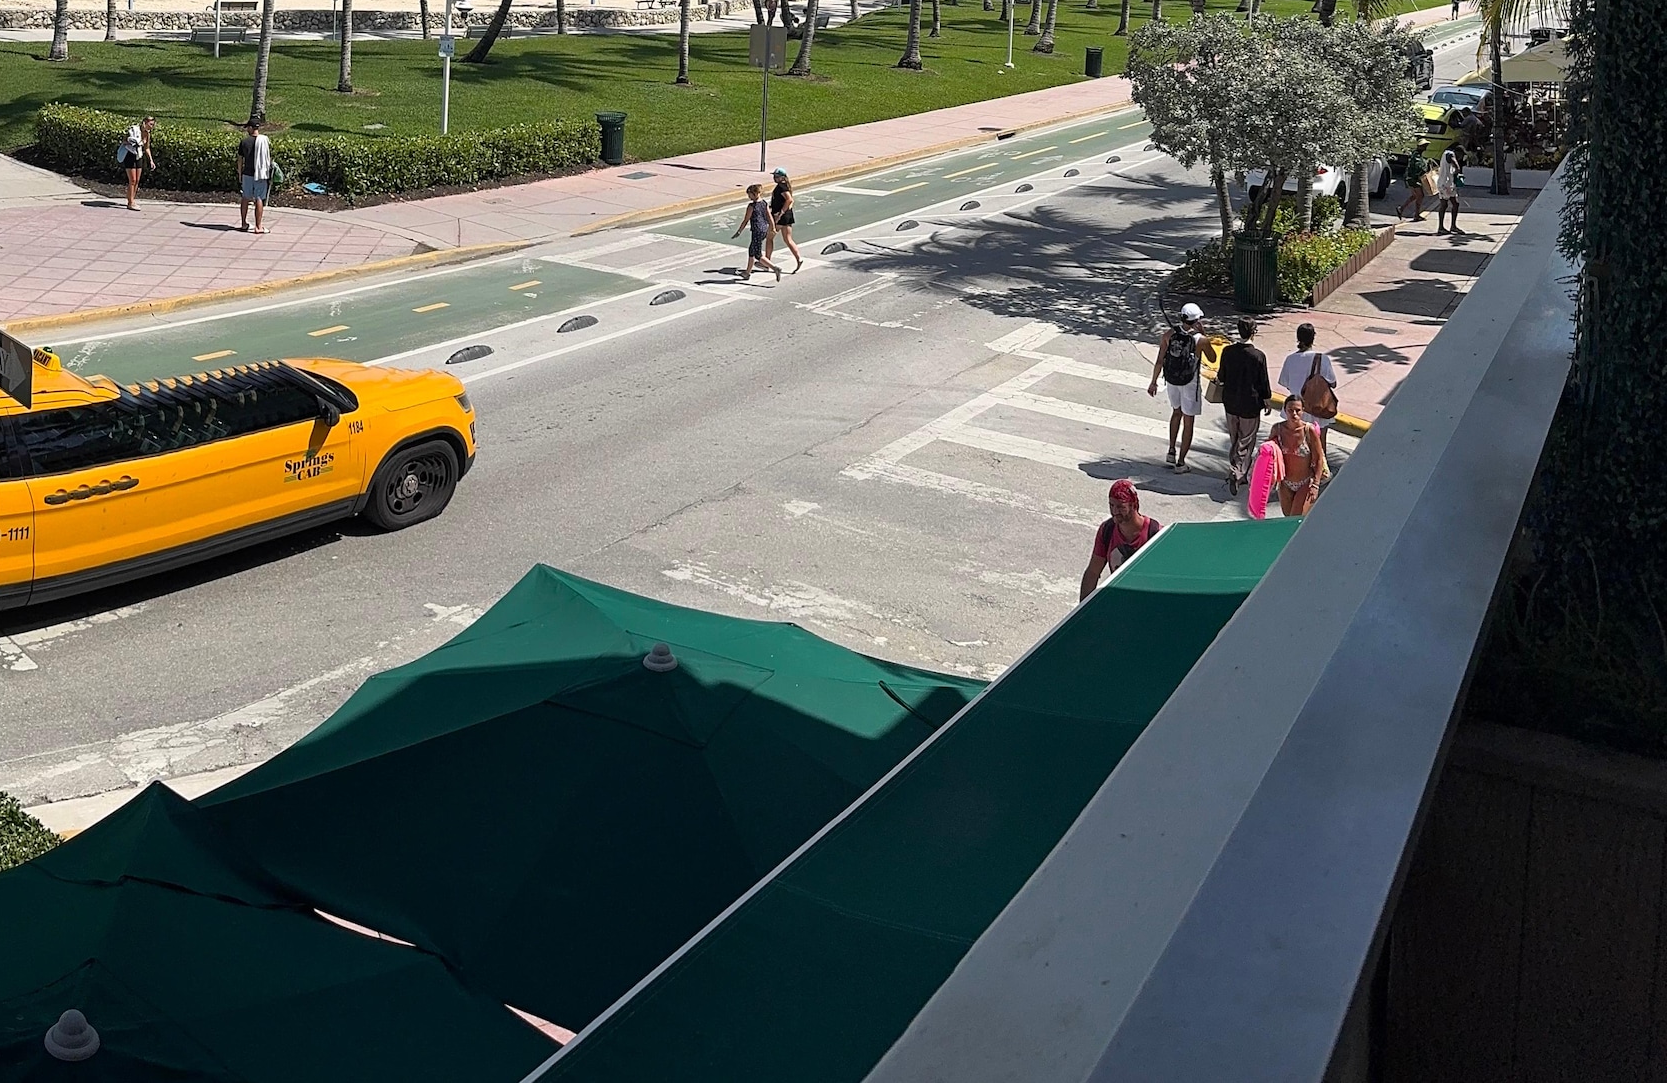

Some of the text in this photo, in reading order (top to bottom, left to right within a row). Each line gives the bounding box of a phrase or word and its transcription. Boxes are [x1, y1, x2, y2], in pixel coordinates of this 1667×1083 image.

[349, 420, 364, 435] 1184
[284, 451, 335, 474] Springs
[297, 467, 322, 481] CAB
